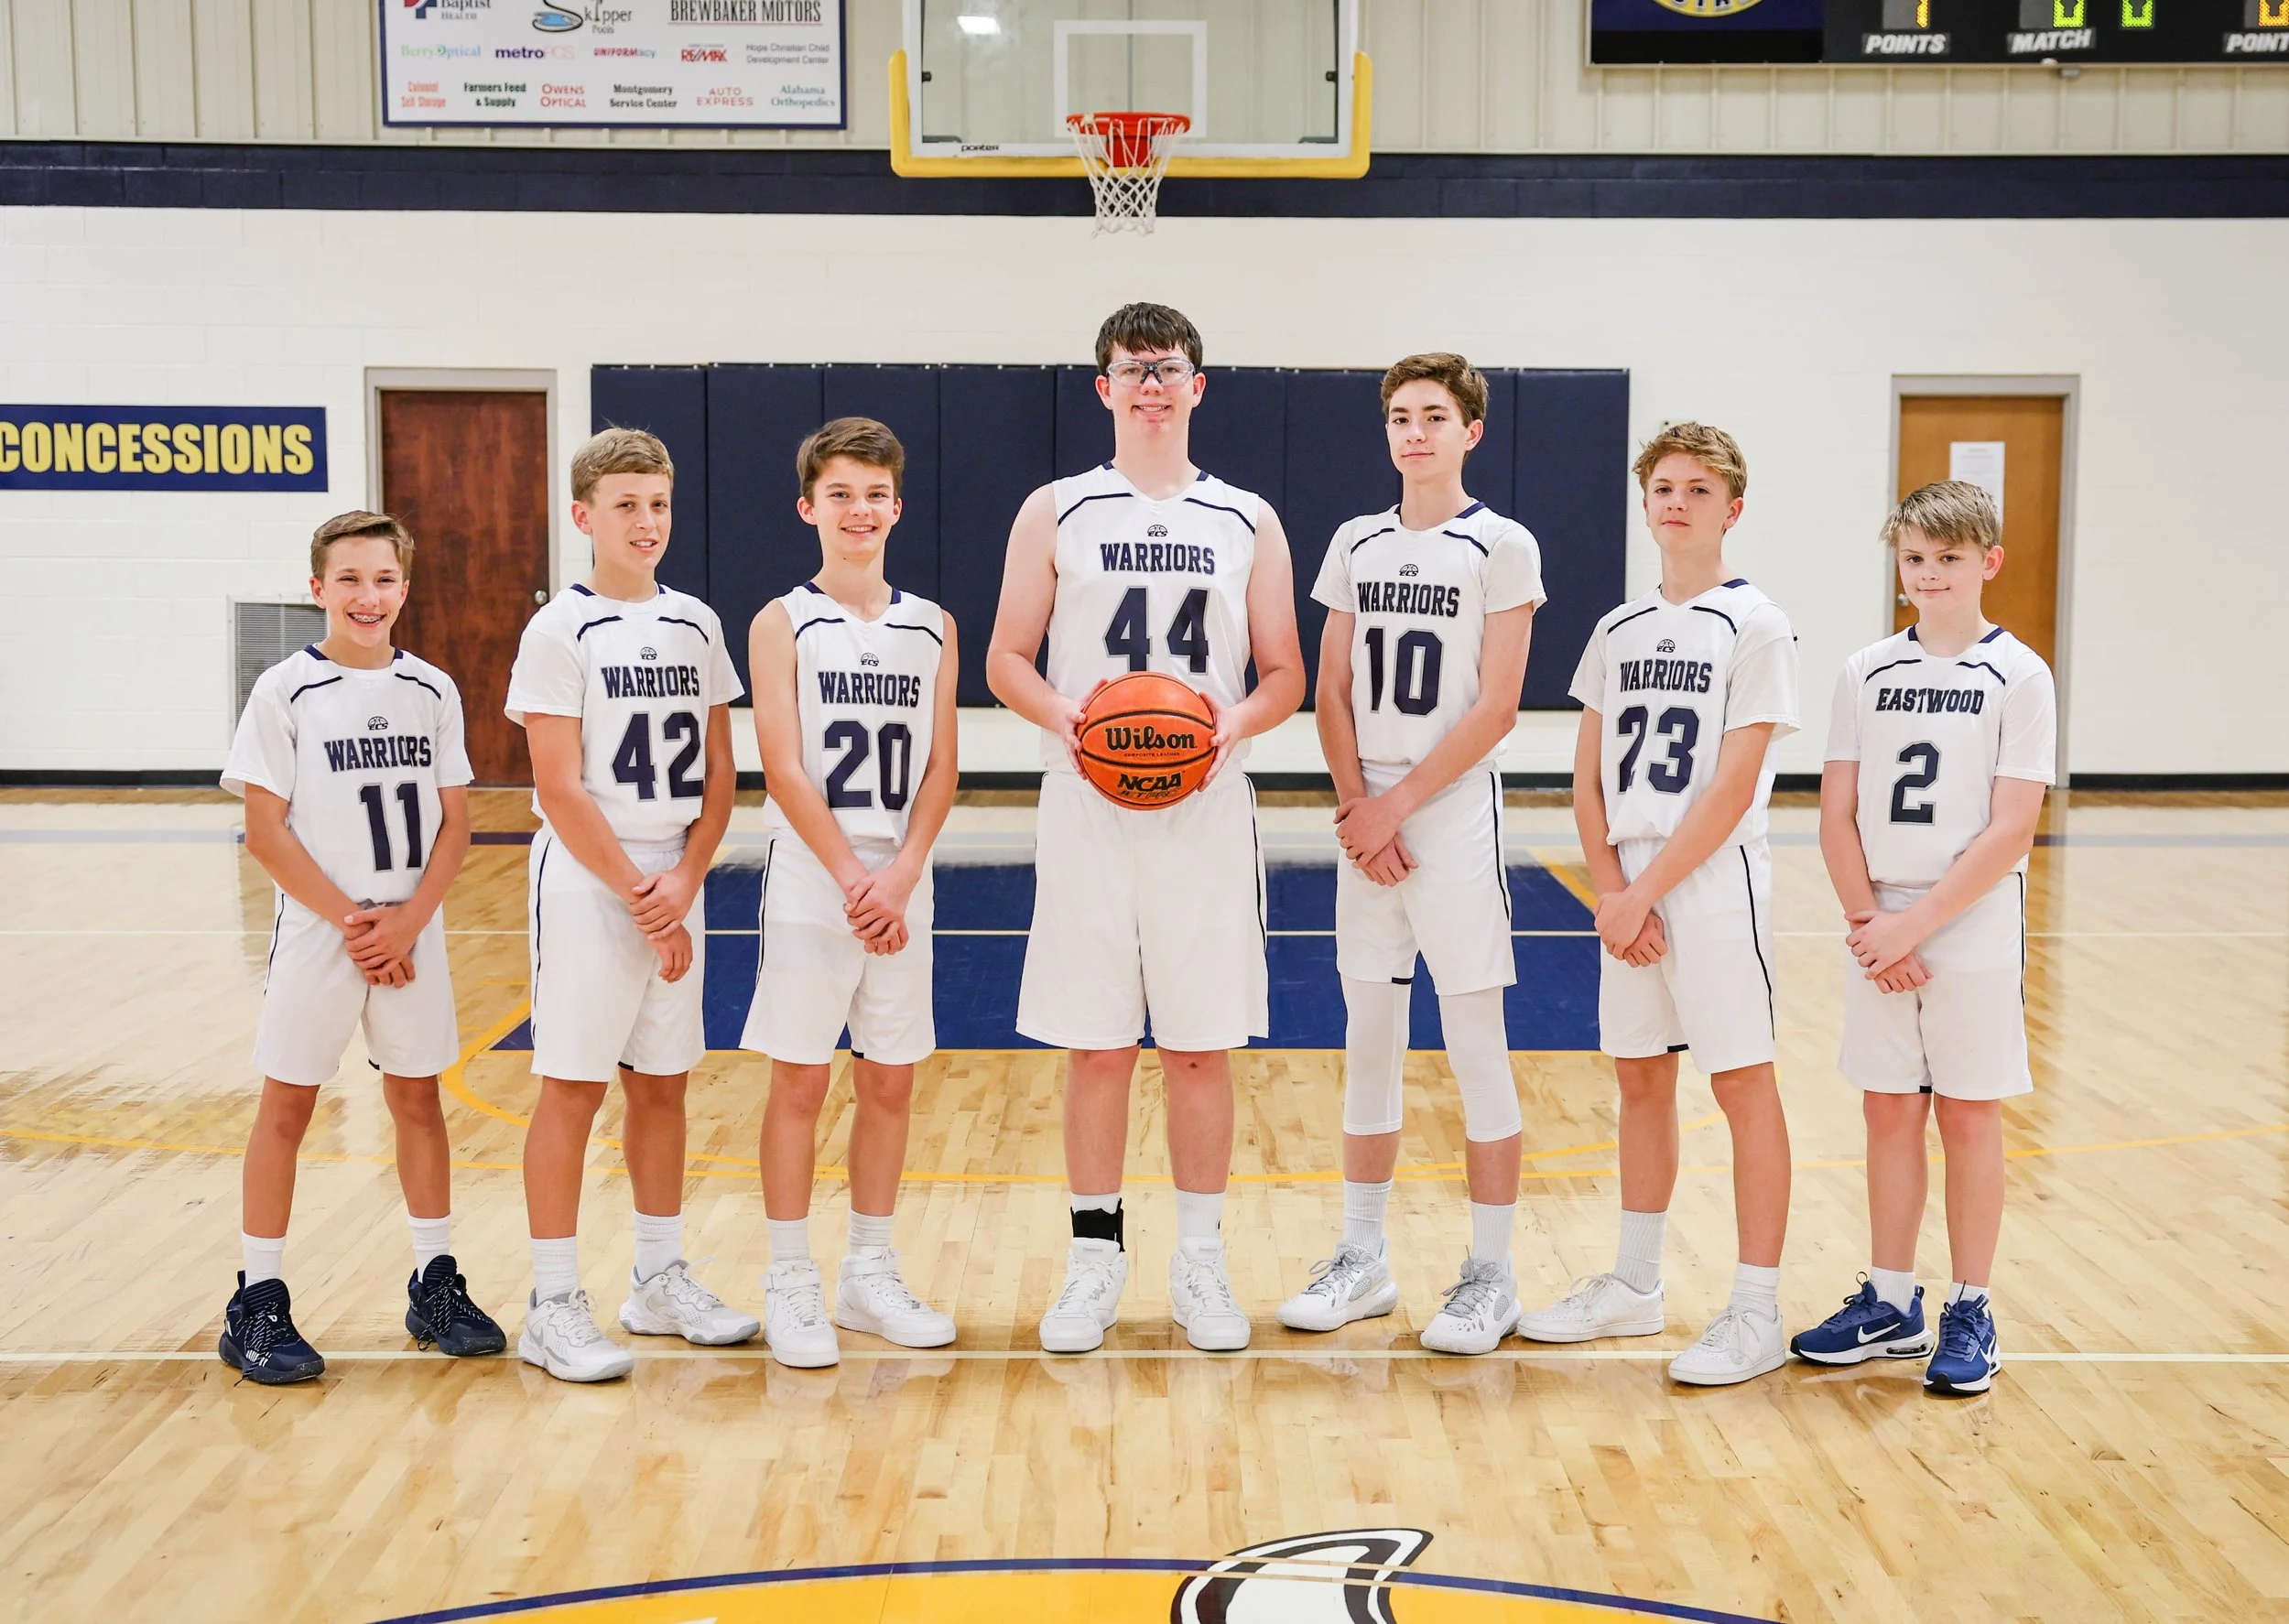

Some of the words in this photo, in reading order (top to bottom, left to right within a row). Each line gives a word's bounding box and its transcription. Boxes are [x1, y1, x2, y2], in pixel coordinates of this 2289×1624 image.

[441, 0, 491, 11] Baptist
[671, 0, 756, 22] BREWBAKER
[762, 0, 821, 22] MOTORS
[1864, 34, 1947, 54] POINTS
[2009, 28, 2092, 54] MATCH
[464, 82, 503, 92] Farmers
[504, 82, 526, 92] Feed
[542, 83, 585, 94] OWENS
[613, 83, 673, 95] Montgomery
[709, 87, 742, 96] AUTO
[780, 85, 826, 95] Alabama
[484, 97, 515, 108] Supply
[540, 96, 586, 108] OPTICAL
[610, 98, 644, 108] Service
[646, 98, 678, 108] Center
[697, 96, 754, 107] EXPRESS
[771, 96, 835, 109] Orthopedics
[0, 422, 314, 474] CONCESSIONS
[1100, 542, 1215, 576] WARRIORS
[1357, 581, 1460, 618] WARRIORS
[1102, 586, 1210, 676] 44
[601, 665, 700, 698] WARRIORS
[1364, 625, 1444, 718] 10
[1620, 659, 1712, 694] WARRIORS
[818, 671, 921, 709] WARRIORS
[1875, 687, 1984, 715] EASTWOOD
[1105, 726, 1195, 751] Wilson
[1616, 704, 1700, 796] 23
[323, 735, 431, 773] WARRIORS
[610, 709, 705, 803] 42
[822, 719, 912, 813] 20
[1118, 773, 1182, 792] NCAA
[1889, 740, 1942, 826] 2
[357, 780, 422, 873] 11
